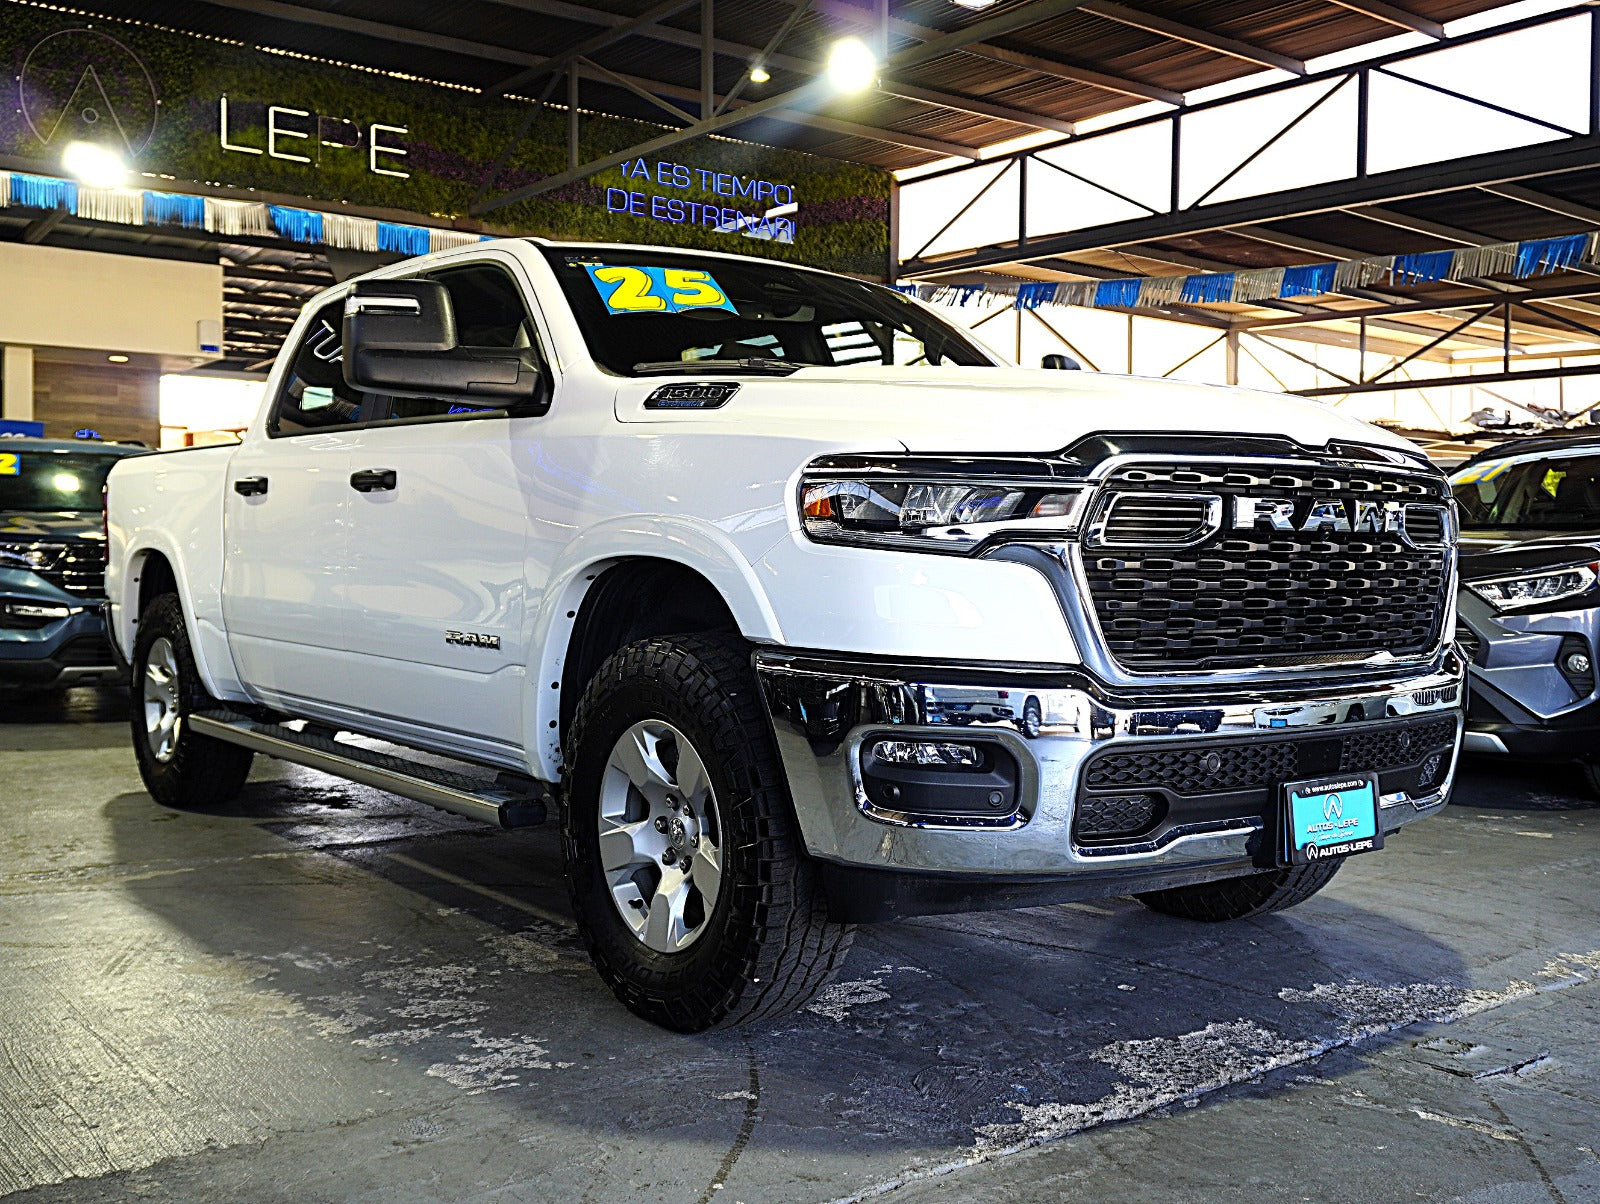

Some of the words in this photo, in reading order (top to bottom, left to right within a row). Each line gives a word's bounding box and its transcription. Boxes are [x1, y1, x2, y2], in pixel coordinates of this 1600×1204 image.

[220, 96, 411, 179] LEPE
[621, 157, 651, 181] YA
[657, 162, 691, 189] ES
[695, 169, 792, 206] TIEMPO
[607, 188, 646, 217] DE
[593, 267, 726, 310] 25
[1233, 495, 1401, 532] RAM
[446, 630, 500, 650] RAM
